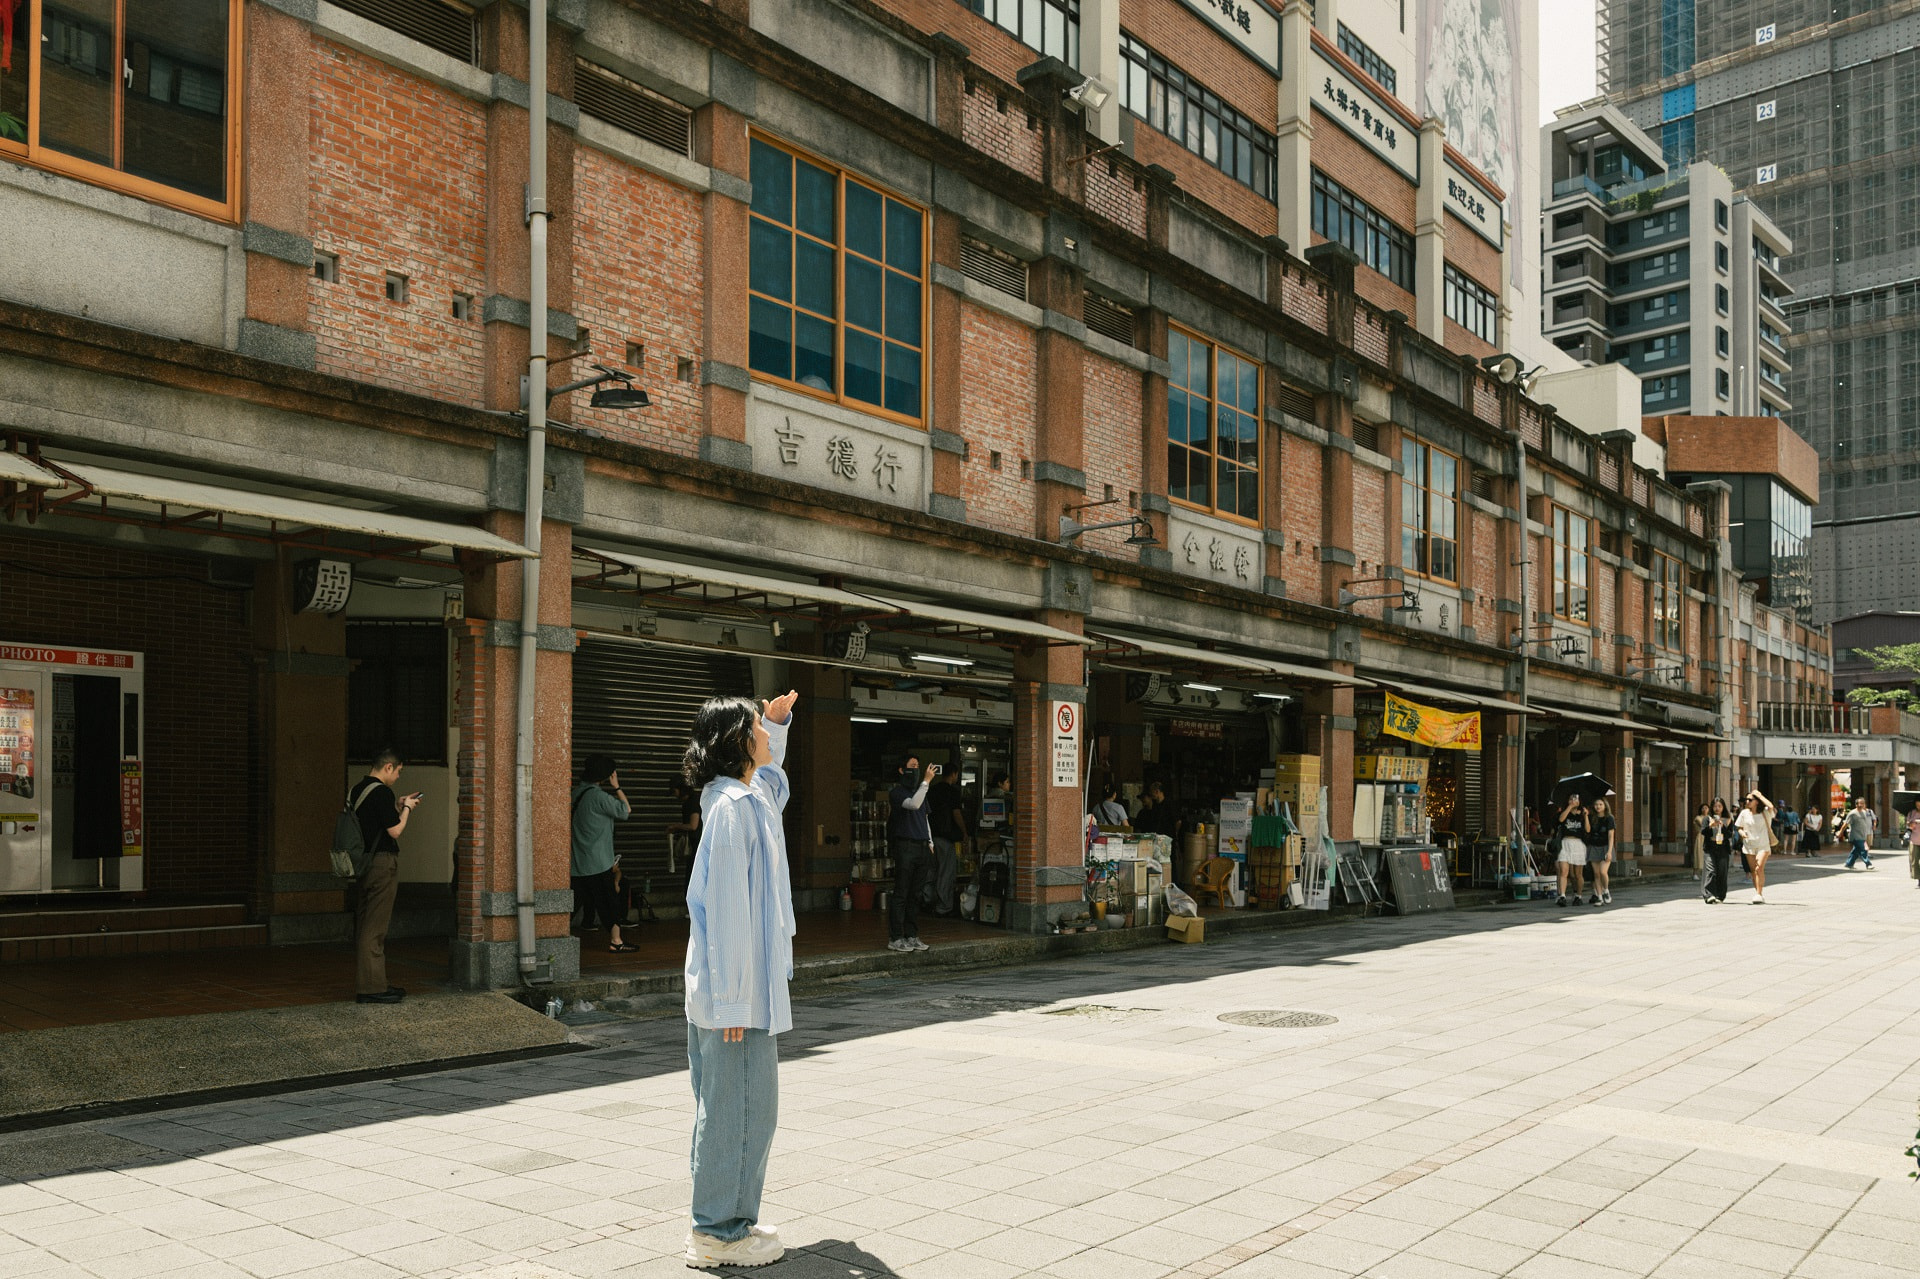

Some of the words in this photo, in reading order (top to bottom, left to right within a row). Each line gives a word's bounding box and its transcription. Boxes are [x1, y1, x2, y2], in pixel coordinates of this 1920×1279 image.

[1758, 27, 1773, 42] 25
[1759, 104, 1773, 119] 23
[1760, 168, 1774, 183] 21
[774, 416, 903, 493] 吉穩行
[1, 646, 56, 662] PHOTO
[76, 652, 126, 668] 證件照
[1061, 711, 1071, 727] 停
[1790, 742, 1837, 757] 大稻埕戲苑
